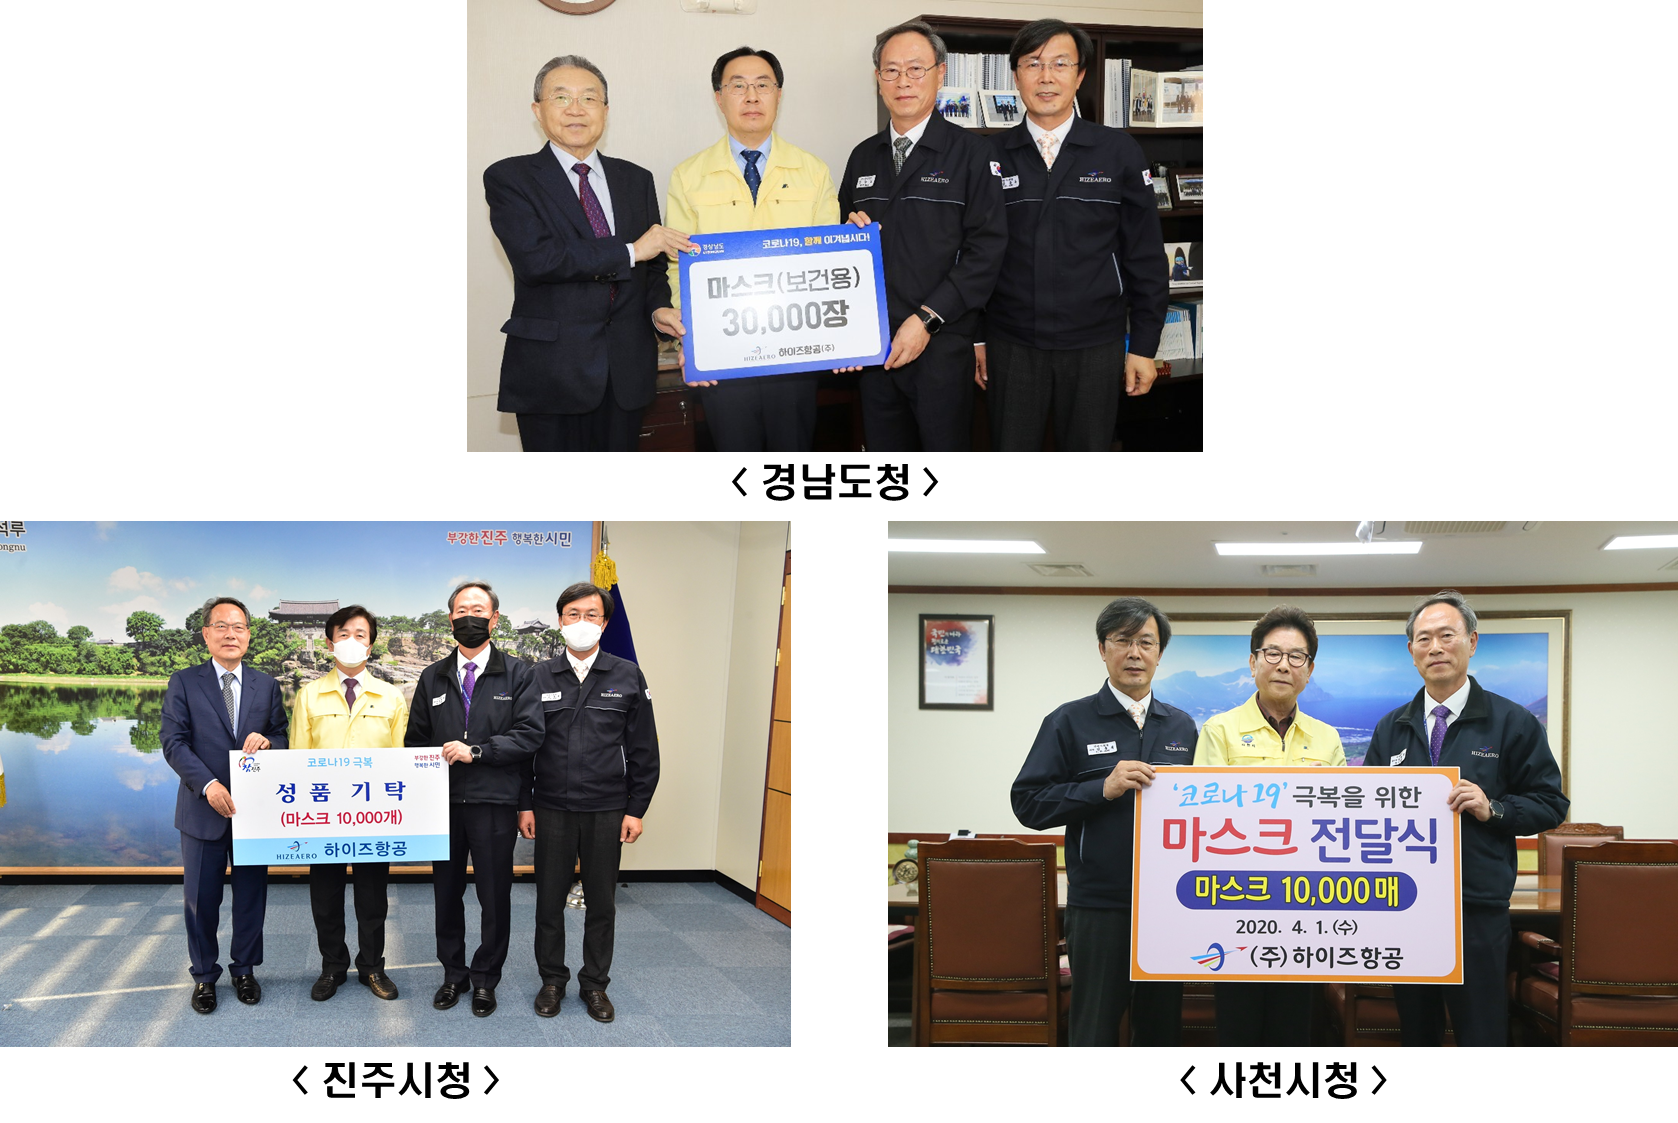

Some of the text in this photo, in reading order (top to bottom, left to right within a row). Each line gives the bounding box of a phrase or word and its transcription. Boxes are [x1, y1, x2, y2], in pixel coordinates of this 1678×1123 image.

[762, 232, 871, 250] 코로나19, 함께 이겨냅시다!
[707, 266, 861, 299] 마스크(보건용)
[722, 299, 850, 337] 30,000장
[743, 353, 776, 362] HIZEAERO
[778, 343, 835, 358] 하이즈항공(주)
[307, 756, 374, 768] 코로나19 극복
[1471, 750, 1500, 759] HIZEAERO
[1292, 785, 1366, 809] 극복을
[1374, 785, 1422, 809] 위한
[280, 809, 403, 828] (마스크 10,000개)
[324, 841, 408, 858] 하이즈항공
[1162, 816, 1438, 865] 마스크 전달식
[1194, 874, 1272, 906] 마스크
[1236, 919, 1282, 935] 2020.
[1291, 919, 1307, 935] 4.
